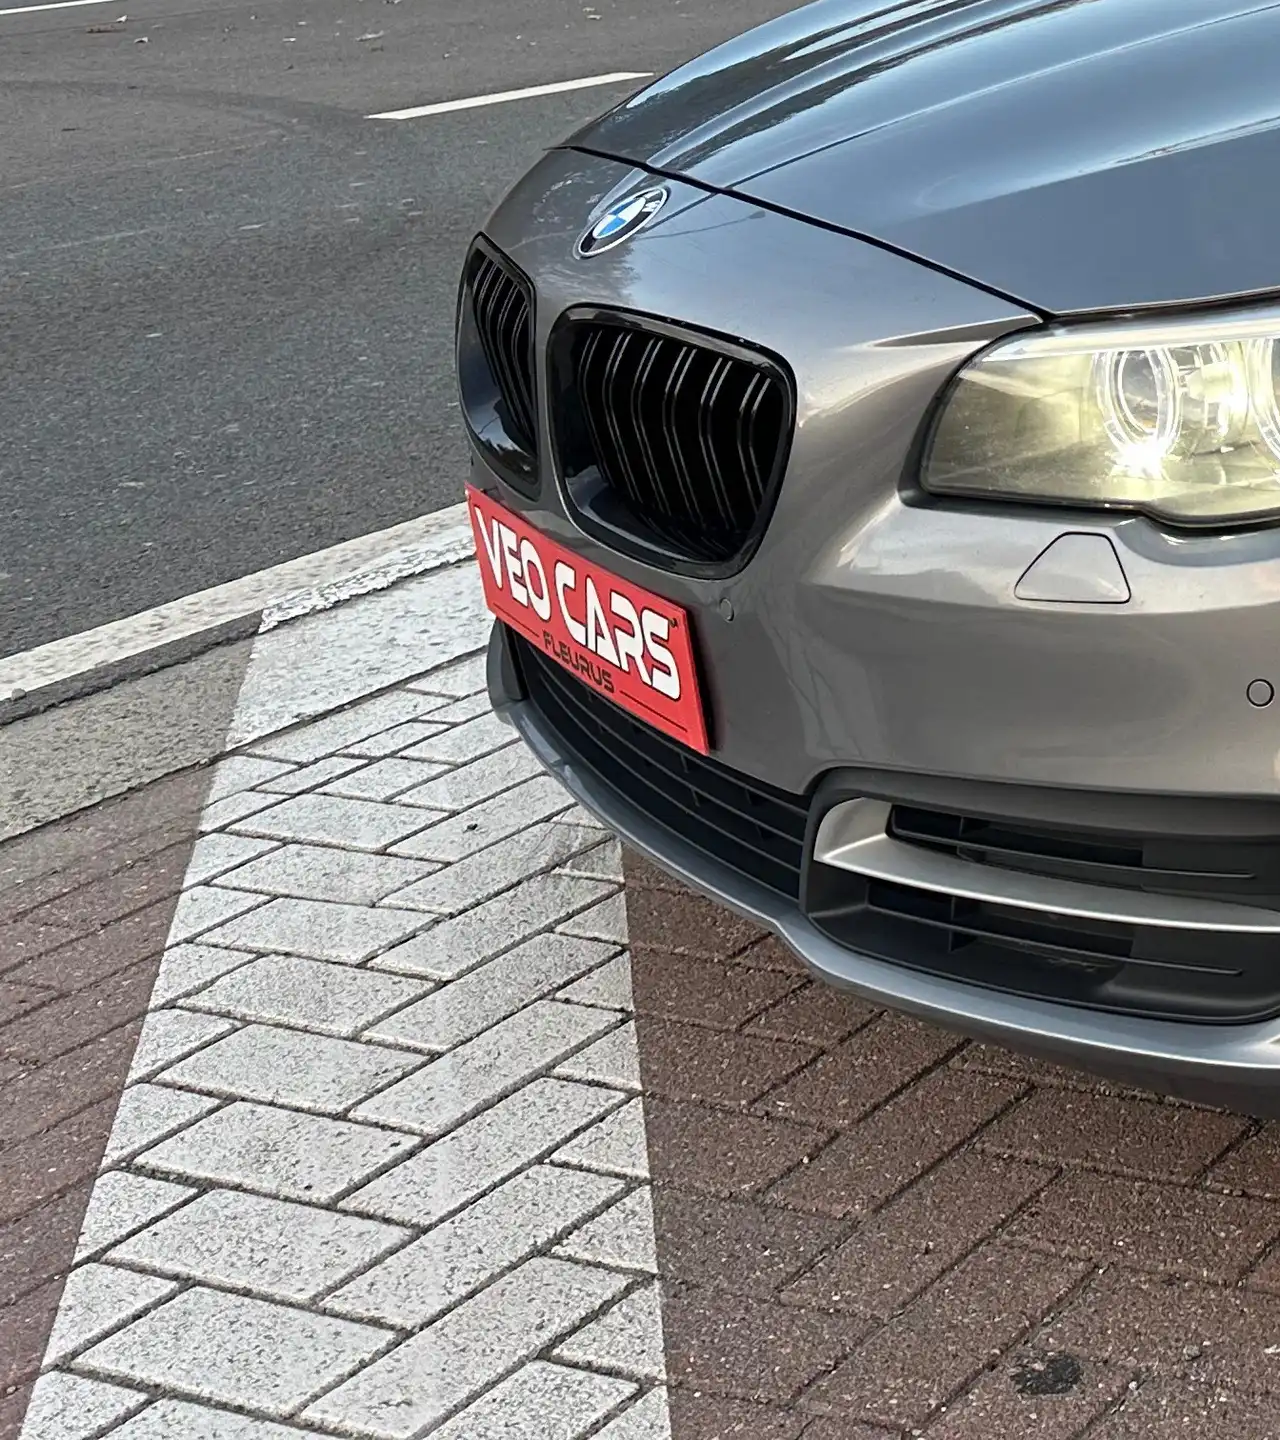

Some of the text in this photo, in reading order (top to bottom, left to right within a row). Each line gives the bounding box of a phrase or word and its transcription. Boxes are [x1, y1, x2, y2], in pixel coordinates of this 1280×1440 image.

[474, 505, 681, 700] VEO CARS
[543, 630, 615, 693] FLEURUS
